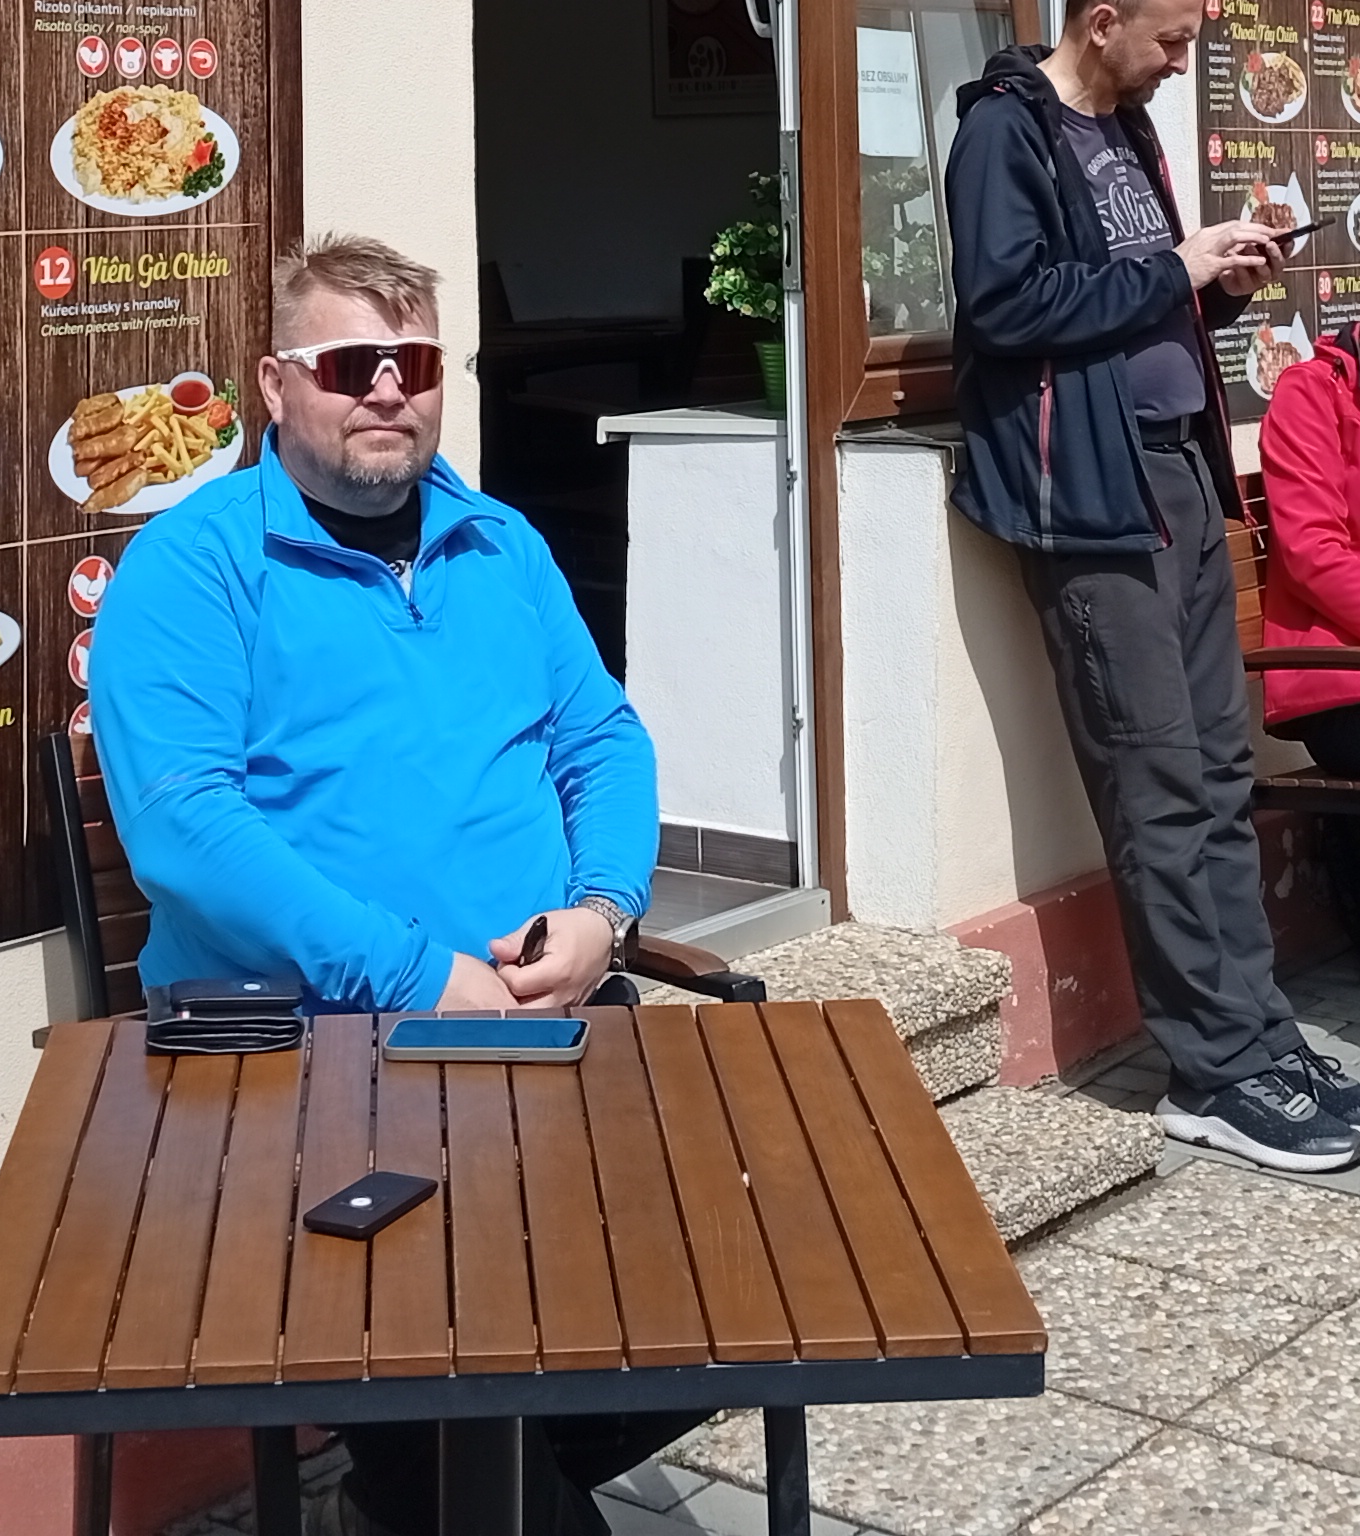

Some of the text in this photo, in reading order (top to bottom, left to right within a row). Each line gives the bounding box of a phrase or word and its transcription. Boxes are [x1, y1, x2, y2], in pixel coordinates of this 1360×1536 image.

[1209, 141, 1221, 157] 25
[1316, 142, 1327, 157] 26
[40, 251, 231, 288] 12 Viên Gà Chiên
[1319, 278, 1331, 293] 30
